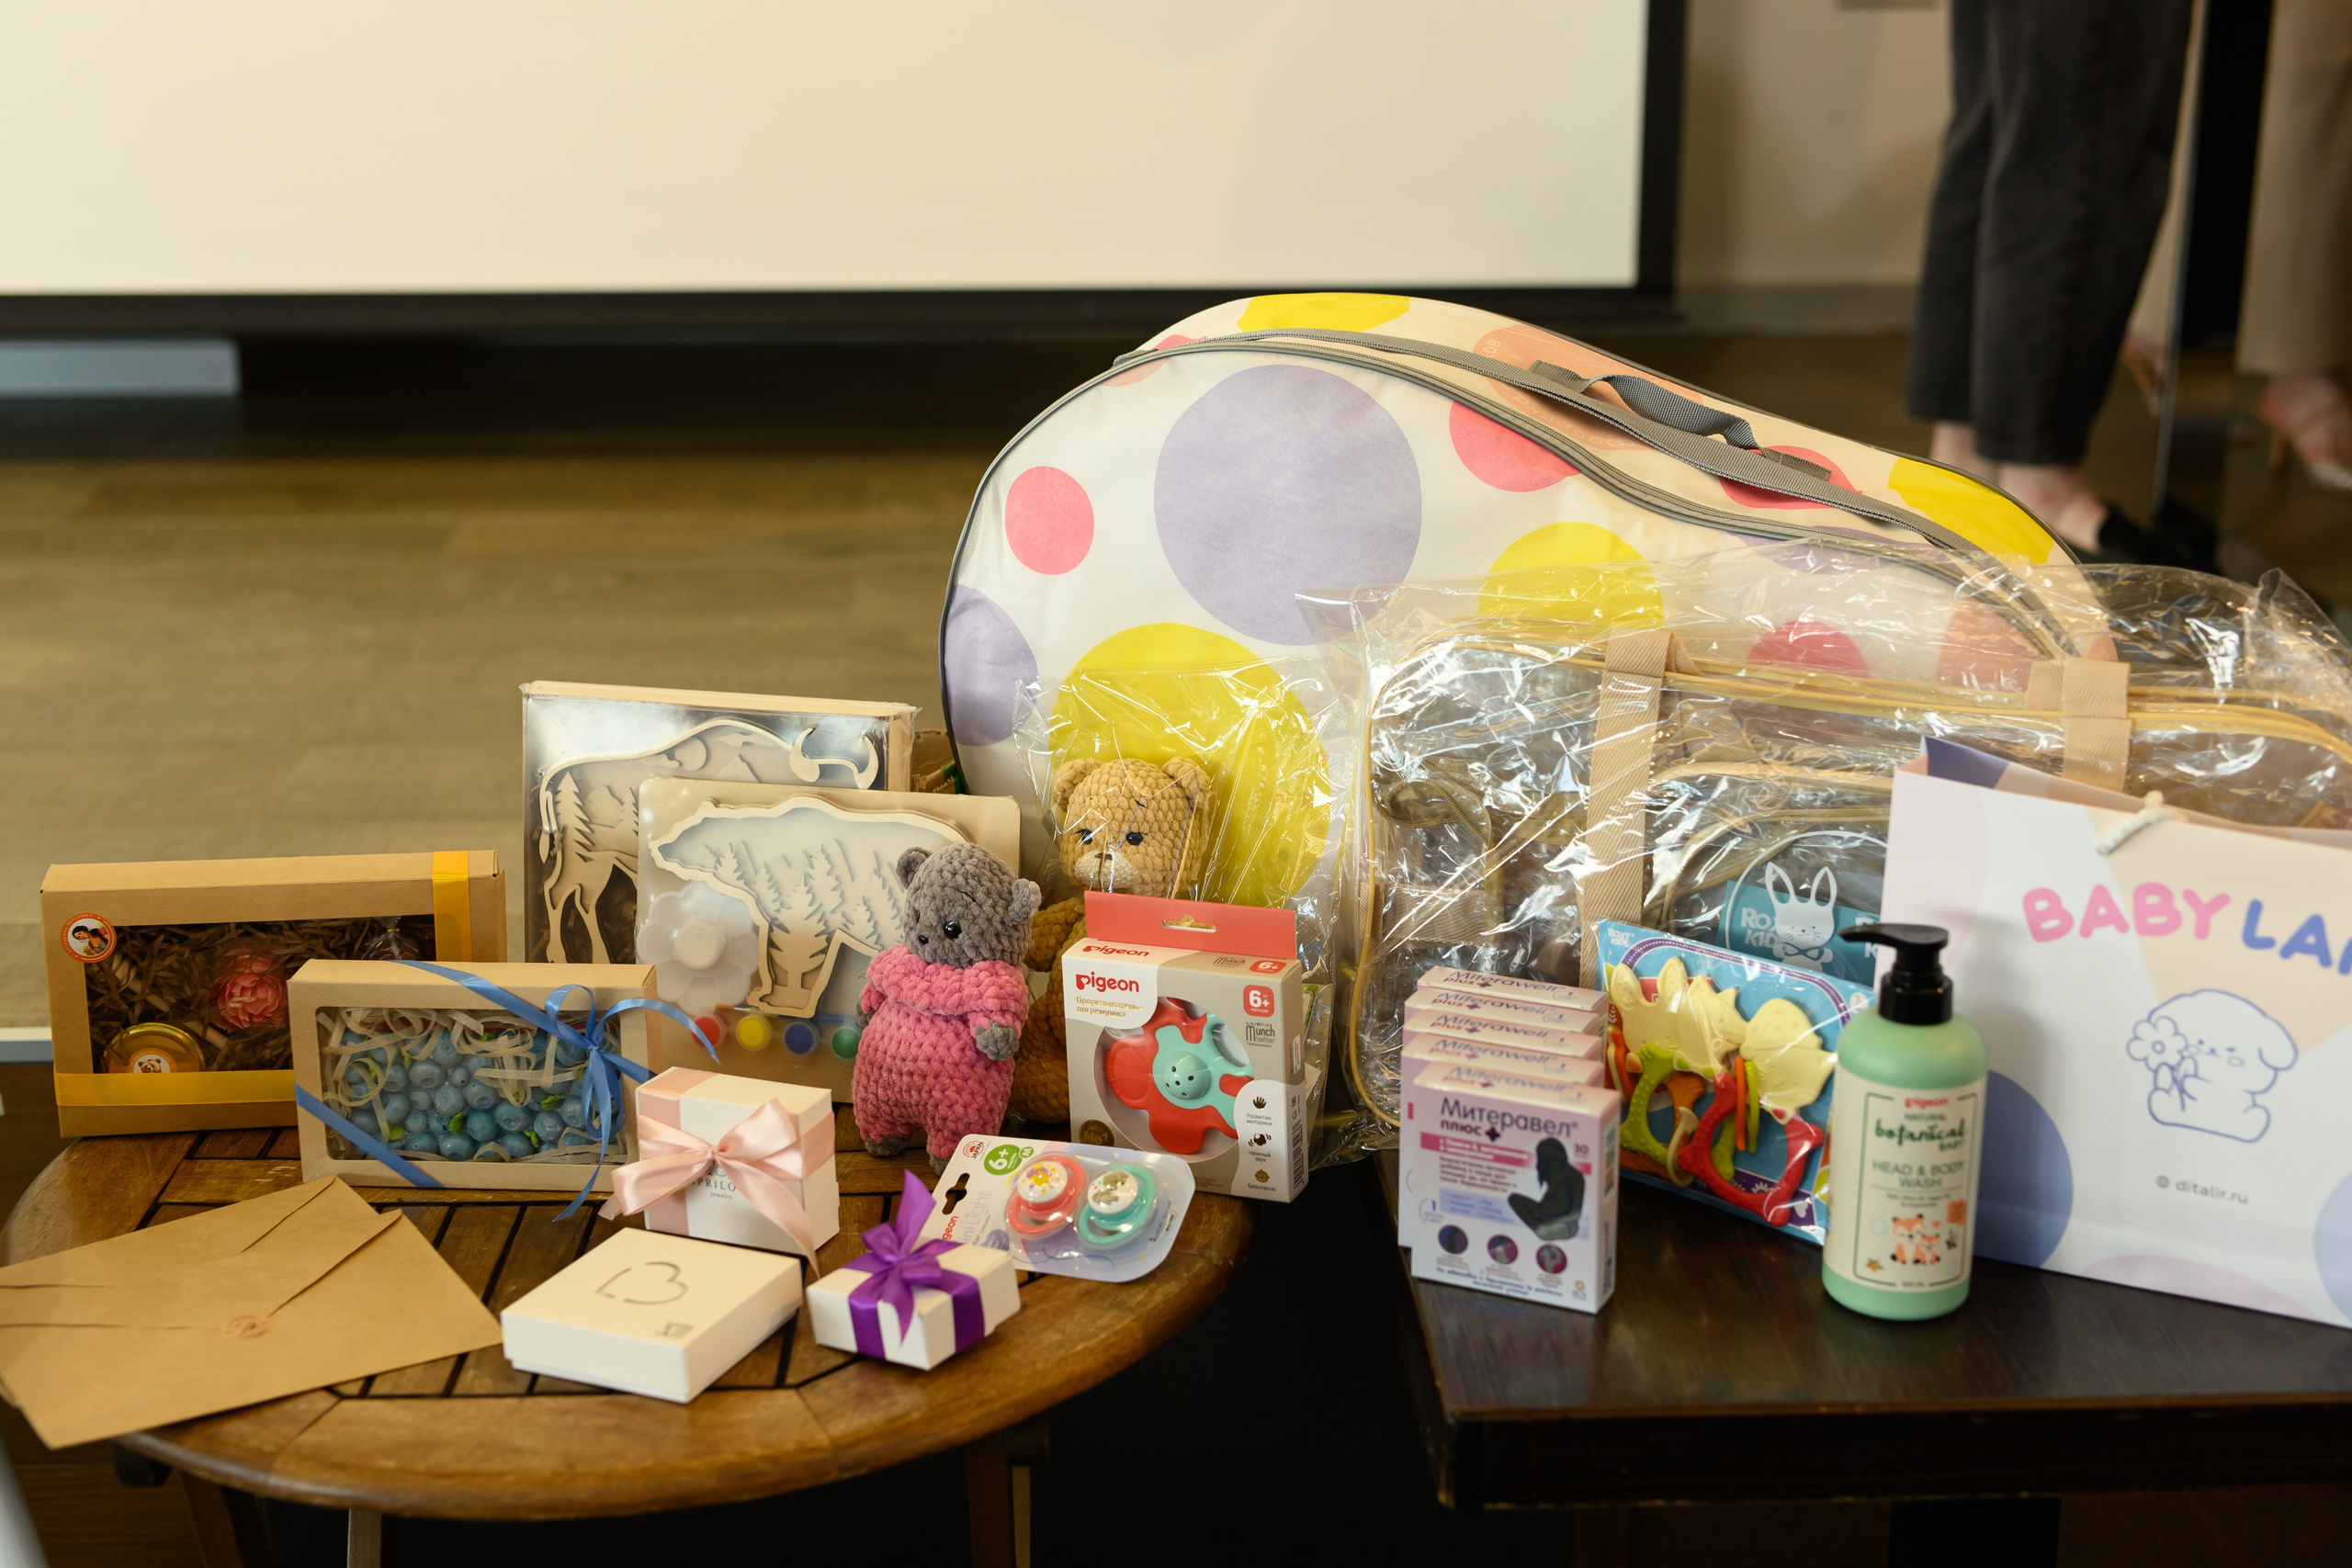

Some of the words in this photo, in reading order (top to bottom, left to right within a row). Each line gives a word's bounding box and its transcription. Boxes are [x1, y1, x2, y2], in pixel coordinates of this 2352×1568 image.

[1740, 907, 1777, 931] RO
[2022, 882, 2232, 942] BABY
[1611, 936, 1629, 948] KIDS
[1744, 929, 1780, 949] KID
[1082, 945, 1149, 956] pigeon
[1076, 971, 1139, 993] pigeon
[1442, 976, 1475, 986] plus
[1449, 970, 1558, 993] Miterawell
[1249, 989, 1270, 1008] 6+
[1430, 998, 1464, 1008] plus
[1437, 991, 1548, 1015] Miterawell
[1077, 1006, 1126, 1018] погремушка
[1246, 1024, 1275, 1042] Munch
[1430, 1020, 1463, 1031] plus
[1435, 1013, 1549, 1039] Miterawell
[1428, 1045, 1462, 1057] plus
[1434, 1038, 1551, 1065] Miterawell
[1448, 1065, 1566, 1093] Miterawell
[1904, 1096, 1949, 1110] pigeon
[1247, 1112, 1272, 1122] Развитие
[1440, 1119, 1483, 1136] плюс
[1875, 1118, 1965, 1146] botanical
[971, 1141, 984, 1159] JAPAN
[988, 1148, 1009, 1170] 6+
[1249, 1149, 1272, 1157] Нежный
[1871, 1158, 1913, 1175] HEAD
[1916, 1164, 1926, 1176] &
[1930, 1159, 1964, 1175] BODY
[692, 1177, 736, 1191] PRILO
[1248, 1182, 1276, 1192] Безопасно
[1898, 1177, 1943, 1189] WASH
[710, 1191, 732, 1201] jewelry
[942, 1214, 959, 1241] geon
